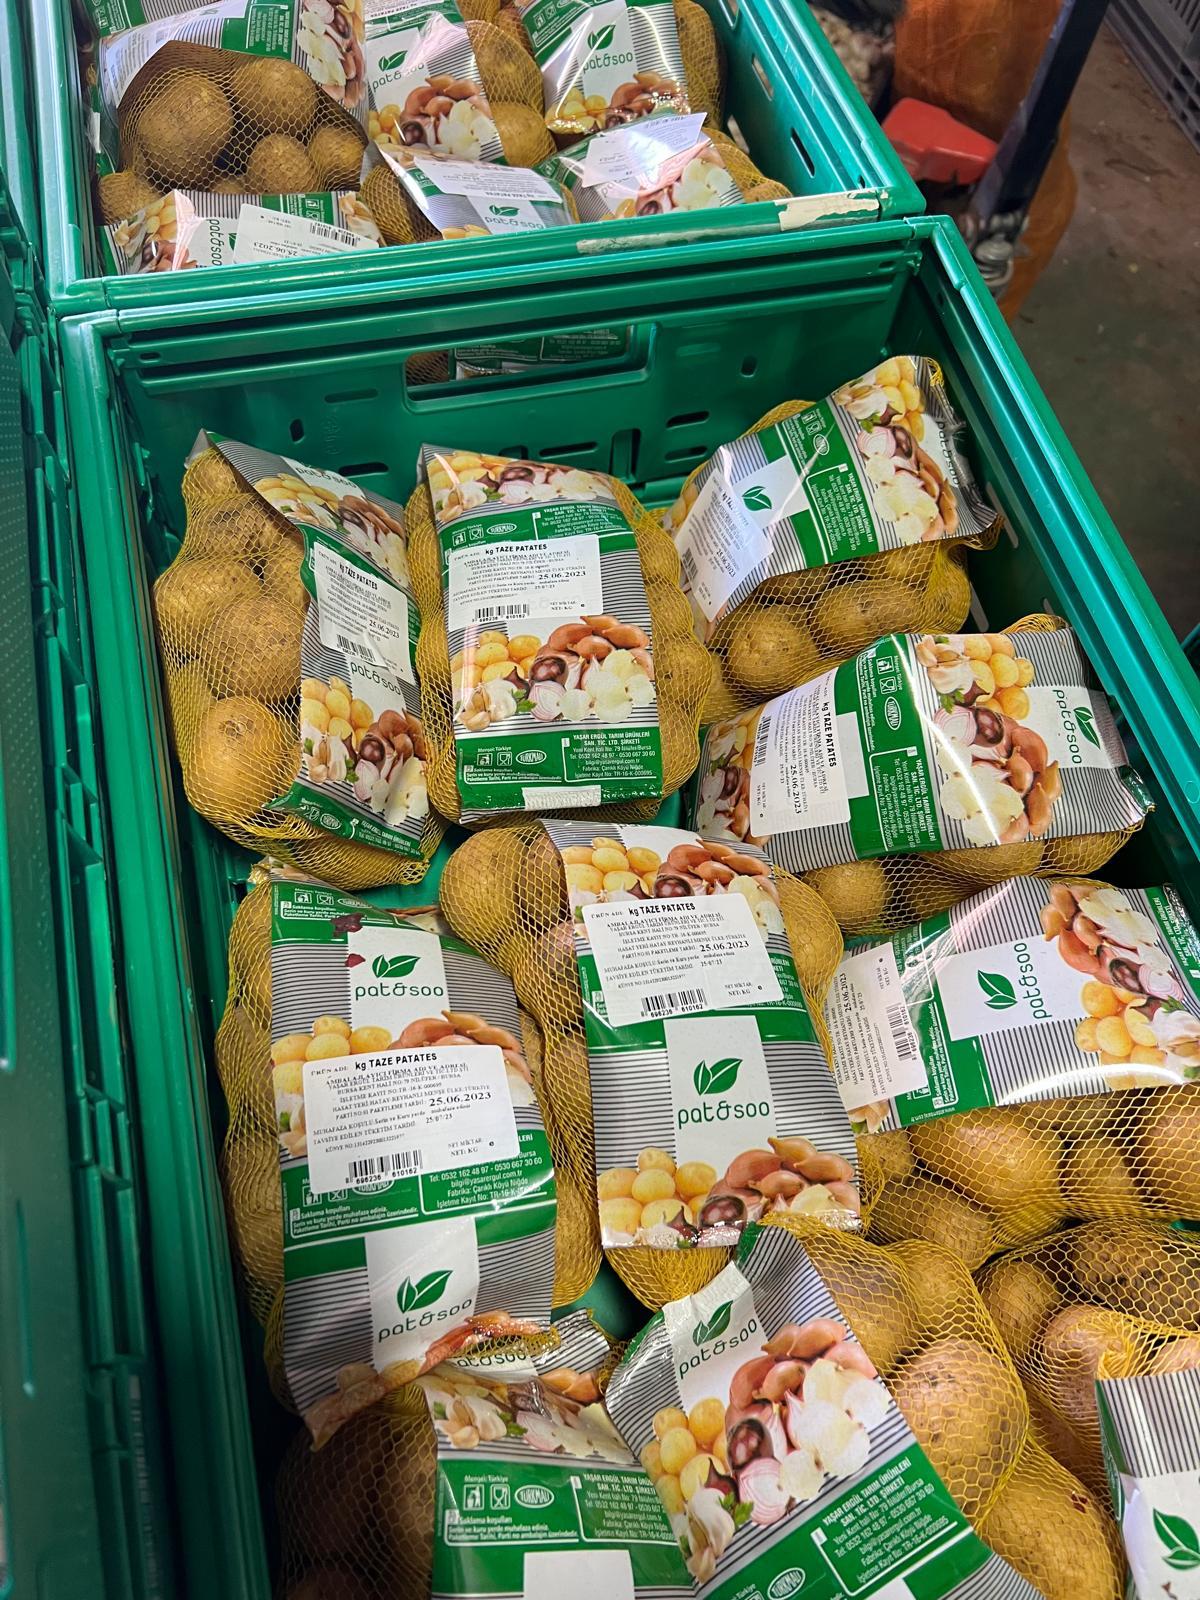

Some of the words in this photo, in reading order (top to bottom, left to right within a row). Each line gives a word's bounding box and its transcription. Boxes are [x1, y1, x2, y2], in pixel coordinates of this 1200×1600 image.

[582, 50, 633, 75] pat&soo
[207, 218, 223, 266] pat&soo
[252, 240, 297, 257] 25.06.2023
[495, 545, 513, 554] TAZE
[515, 542, 548, 553] PATATES
[343, 567, 358, 578] TAZE
[354, 573, 379, 590] PATATES
[537, 569, 586, 581] 25.06.2023
[367, 618, 400, 640] 25.06.2023
[350, 659, 401, 698] pat&soo
[821, 701, 830, 711] kg
[822, 712, 832, 731] TAZE
[1052, 689, 1084, 765] pat&soo
[824, 733, 837, 767] PATATES
[787, 764, 803, 814] 25.06.2023
[919, 777, 927, 795] ERGÜL
[921, 795, 929, 814] TARIM
[628, 907, 639, 917] kg
[640, 904, 660, 915] TAZE
[661, 900, 695, 914] PATATES
[699, 938, 749, 953] 25.06.2023
[355, 982, 444, 1000] pat&soo
[1013, 942, 1053, 1020] pat&soo
[838, 972, 852, 1012] 25.06.2023
[680, 1003, 703, 1012] 610162
[354, 1060, 367, 1071] kg
[369, 1056, 393, 1068] TAZE
[395, 1050, 437, 1065] PATATES
[428, 1089, 491, 1108] 25.06.2023
[677, 1100, 770, 1130] pat&soo
[355, 1173, 381, 1184] 696236
[391, 1167, 417, 1177] 610162
[429, 1174, 440, 1182] Tel:
[440, 1171, 457, 1179] 0532
[458, 1169, 471, 1177] 162
[480, 1165, 488, 1173] 97
[494, 1162, 510, 1170] 0530
[510, 1160, 523, 1168] 667
[533, 1156, 543, 1164] 60
[450, 1169, 523, 1187] bilgi@yasarergul.com.tr
[447, 1186, 472, 1197] Fabrika:
[493, 1180, 509, 1190] Köyü
[477, 1192, 488, 1200] No:
[378, 1298, 473, 1343] pat&soo
[678, 1318, 757, 1379] pat&soo
[821, 1507, 845, 1526] YAŞAR
[841, 1493, 862, 1511] ERGÜL
[860, 1479, 881, 1497] TARIM
[877, 1457, 912, 1484] ÜRÜNLERİ
[840, 1511, 857, 1526] SAN.
[854, 1502, 868, 1515] TİC.
[865, 1493, 882, 1507] LTD.
[878, 1476, 906, 1498] ŞİRKETİ
[844, 1534, 862, 1549] 0532
[859, 1527, 872, 1538] 162
[915, 1488, 926, 1499] 30
